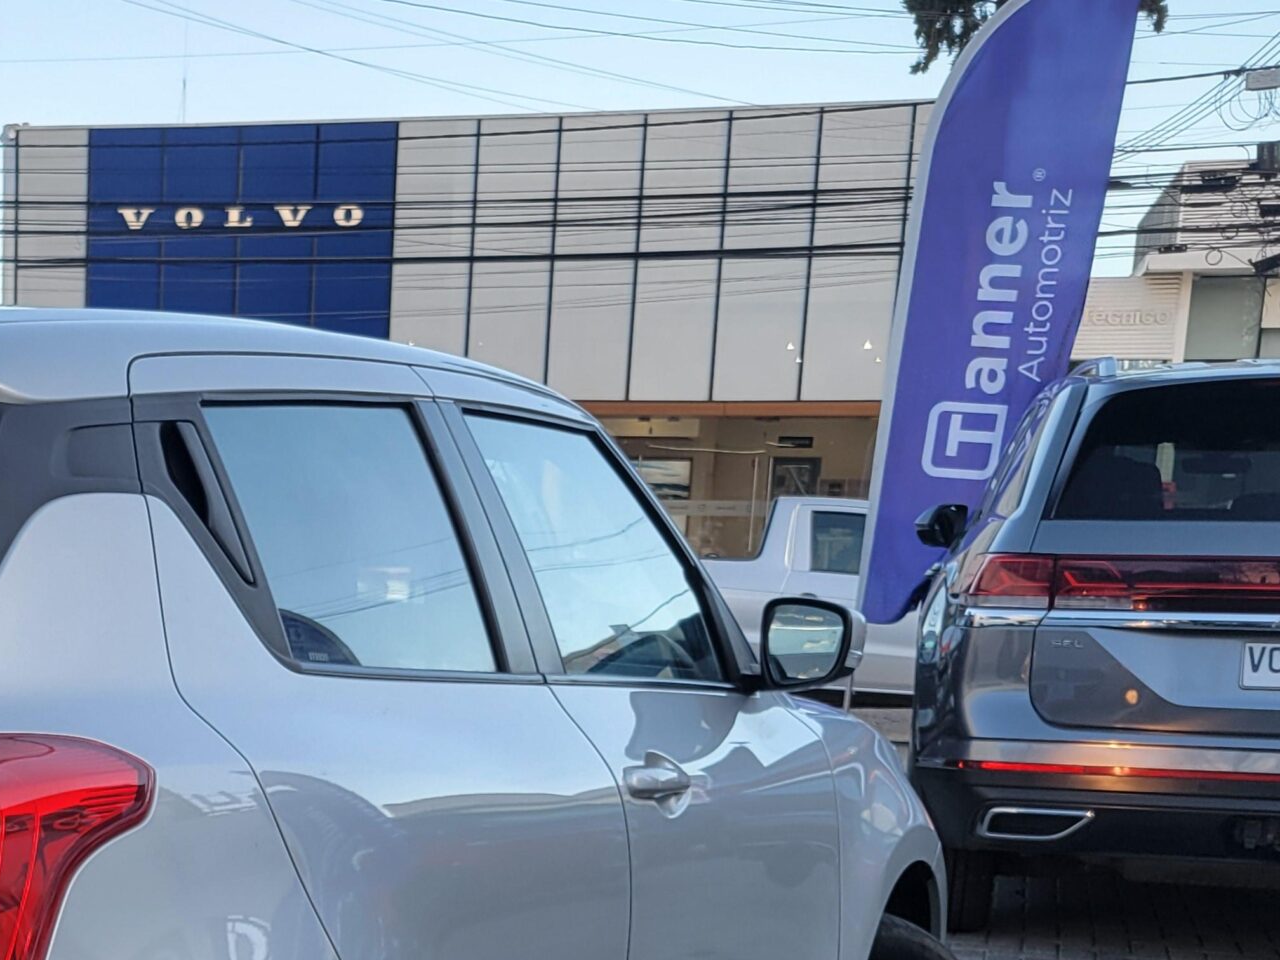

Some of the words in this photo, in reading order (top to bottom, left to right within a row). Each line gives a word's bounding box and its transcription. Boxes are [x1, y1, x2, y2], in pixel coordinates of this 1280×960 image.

[116, 204, 366, 231] VOLVO
[1017, 187, 1074, 383] Automotriz
[921, 181, 1033, 480] Tanner
